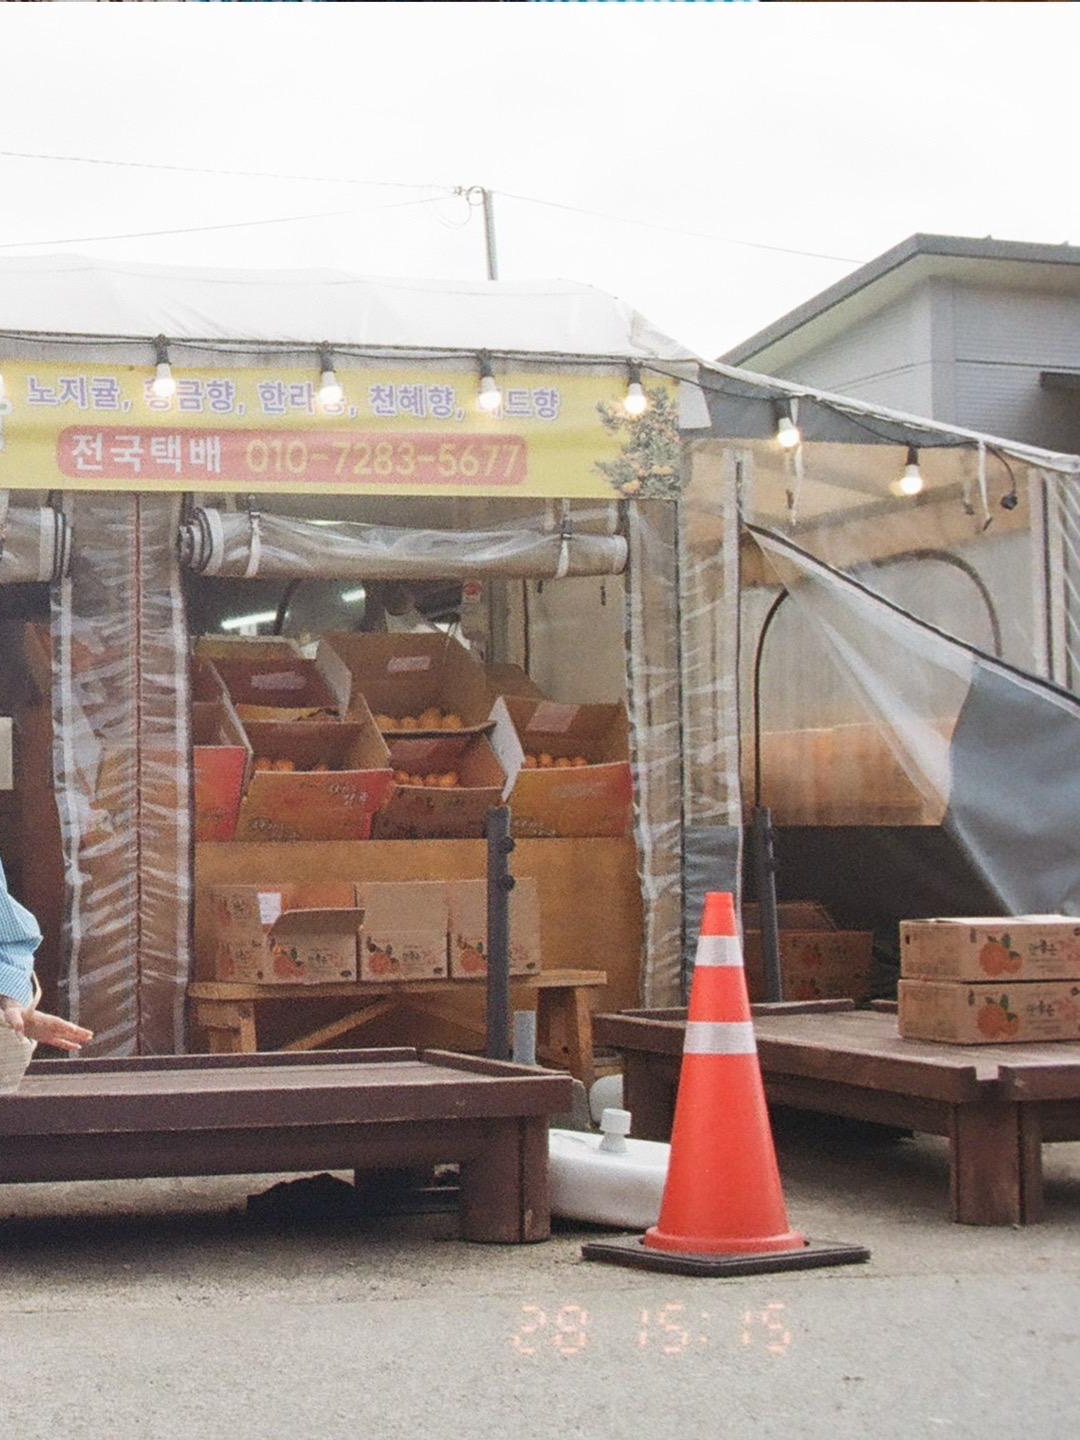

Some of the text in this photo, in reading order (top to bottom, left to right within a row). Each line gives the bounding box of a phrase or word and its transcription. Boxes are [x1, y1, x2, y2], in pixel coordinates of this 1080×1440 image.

[27, 375, 133, 410] 노지귤,
[258, 382, 358, 416] 한라,
[369, 384, 464, 419] 천혜향,
[482, 388, 559, 418] 드향
[71, 430, 521, 478] 전국택배 010-7283-5677
